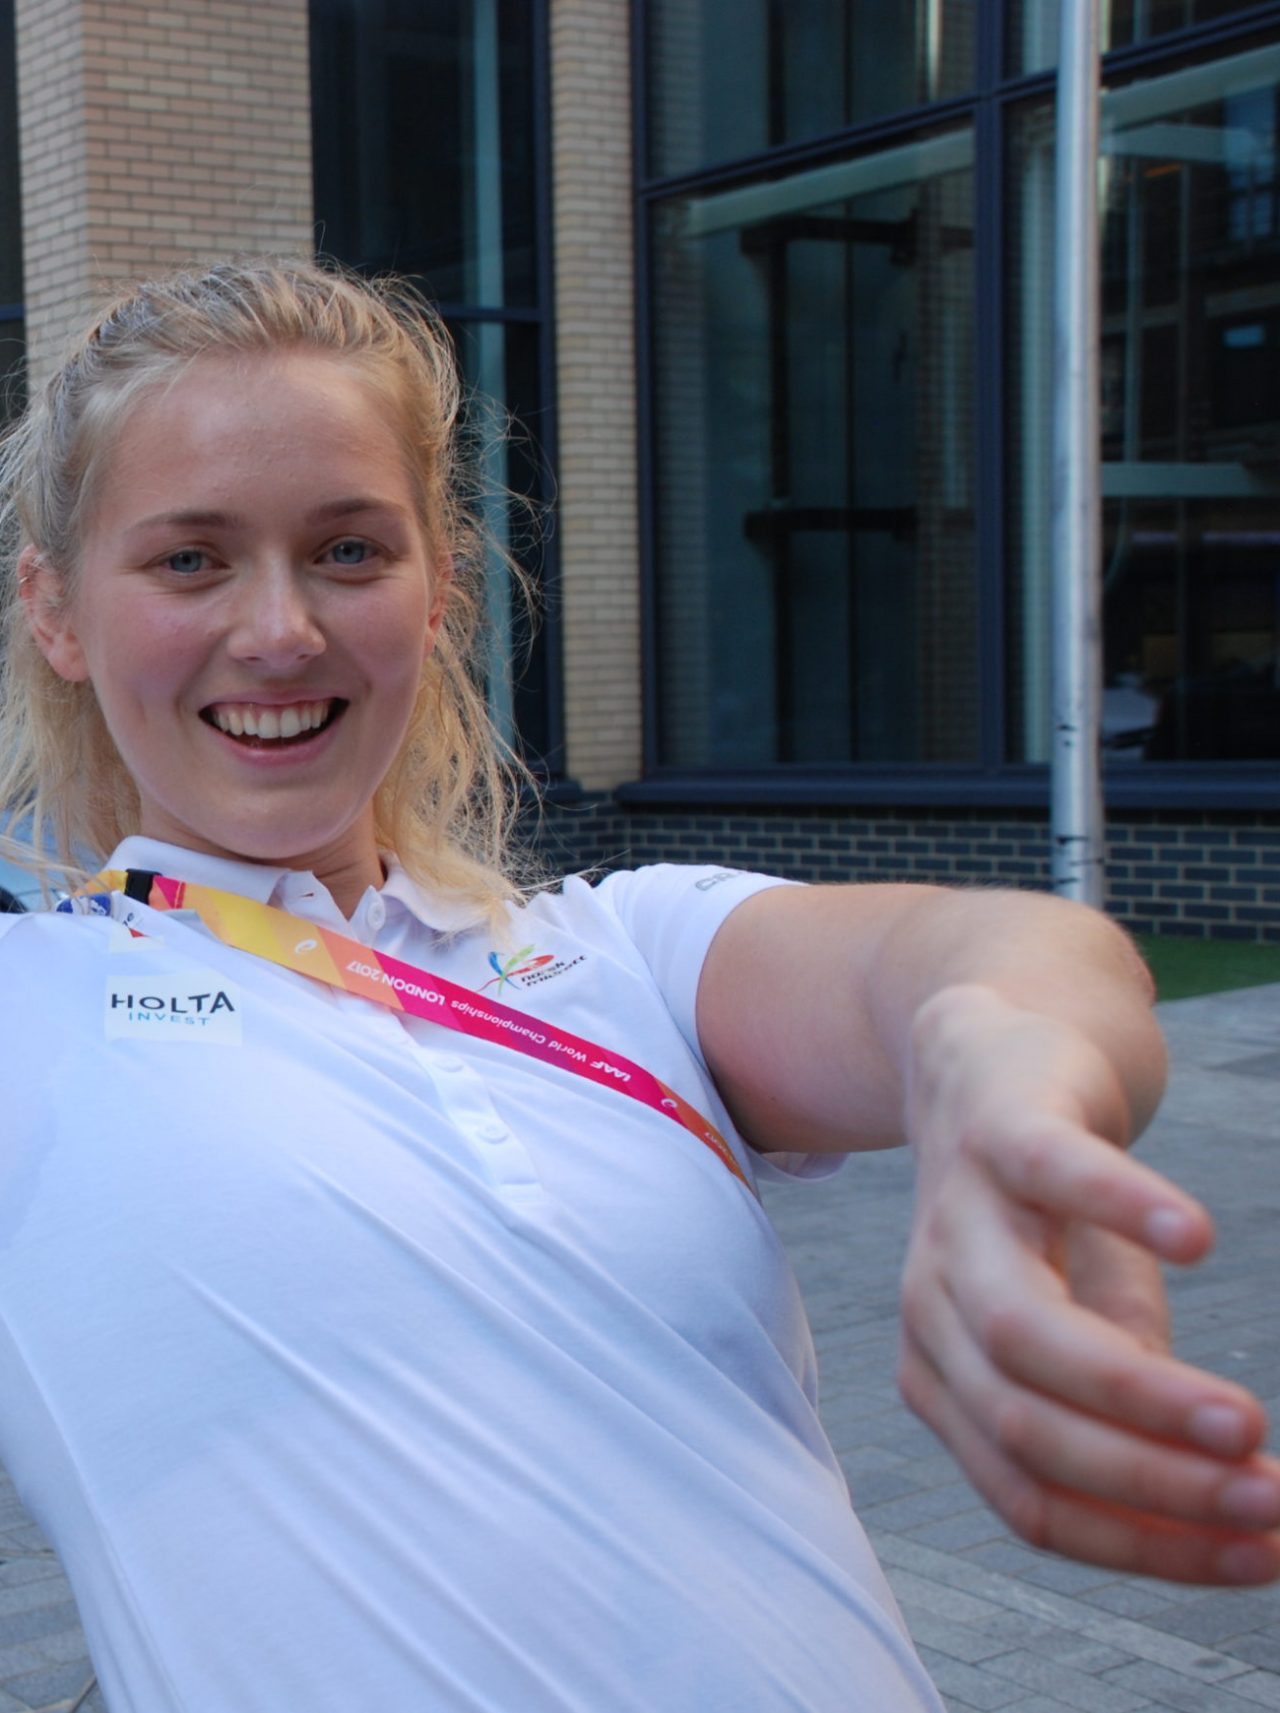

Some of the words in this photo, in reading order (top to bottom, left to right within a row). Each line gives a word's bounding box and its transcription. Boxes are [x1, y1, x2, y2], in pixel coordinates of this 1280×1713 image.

[345, 960, 380, 982] 2017
[381, 972, 446, 1006] LONDON
[110, 991, 235, 1014] HOLTA
[128, 1012, 211, 1026] INVEST
[450, 999, 548, 1045] Championships
[548, 1040, 588, 1062] World
[590, 1060, 632, 1083] IAAF
